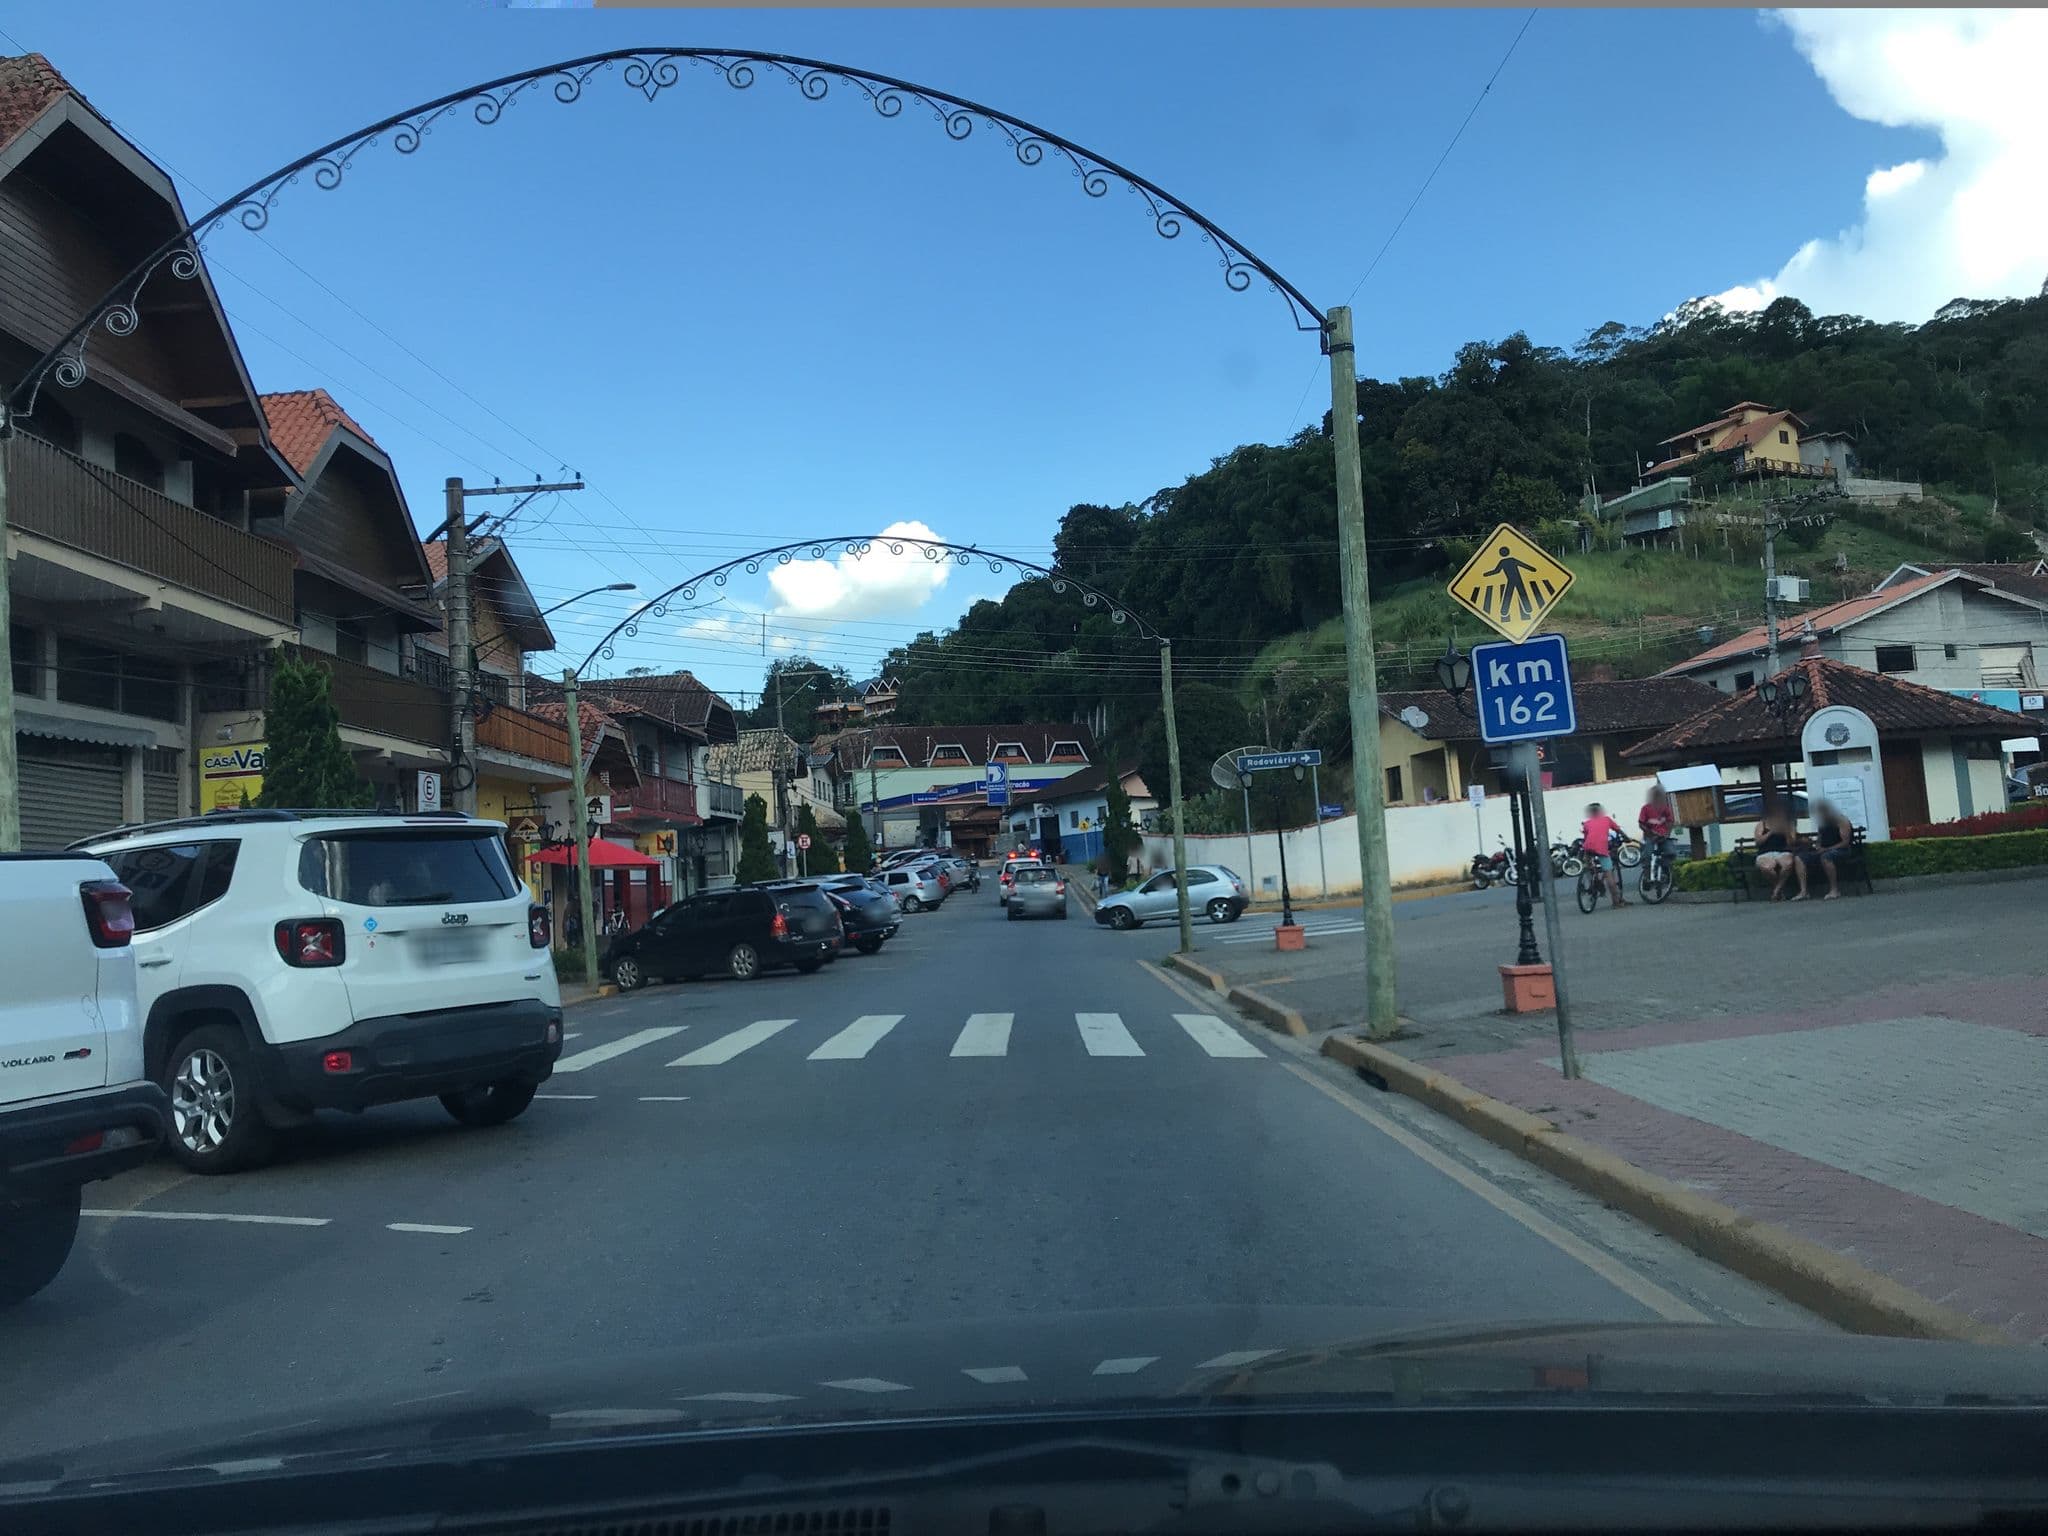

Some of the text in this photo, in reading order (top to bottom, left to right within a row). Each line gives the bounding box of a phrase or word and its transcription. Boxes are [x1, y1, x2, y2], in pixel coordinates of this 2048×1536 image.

[1489, 658, 1553, 687] km
[1494, 691, 1557, 726] 162
[1247, 756, 1297, 767] Rodoviária
[426, 780, 433, 796] E
[441, 911, 469, 926] Jeep
[1, 1054, 56, 1069] VOLCANO
